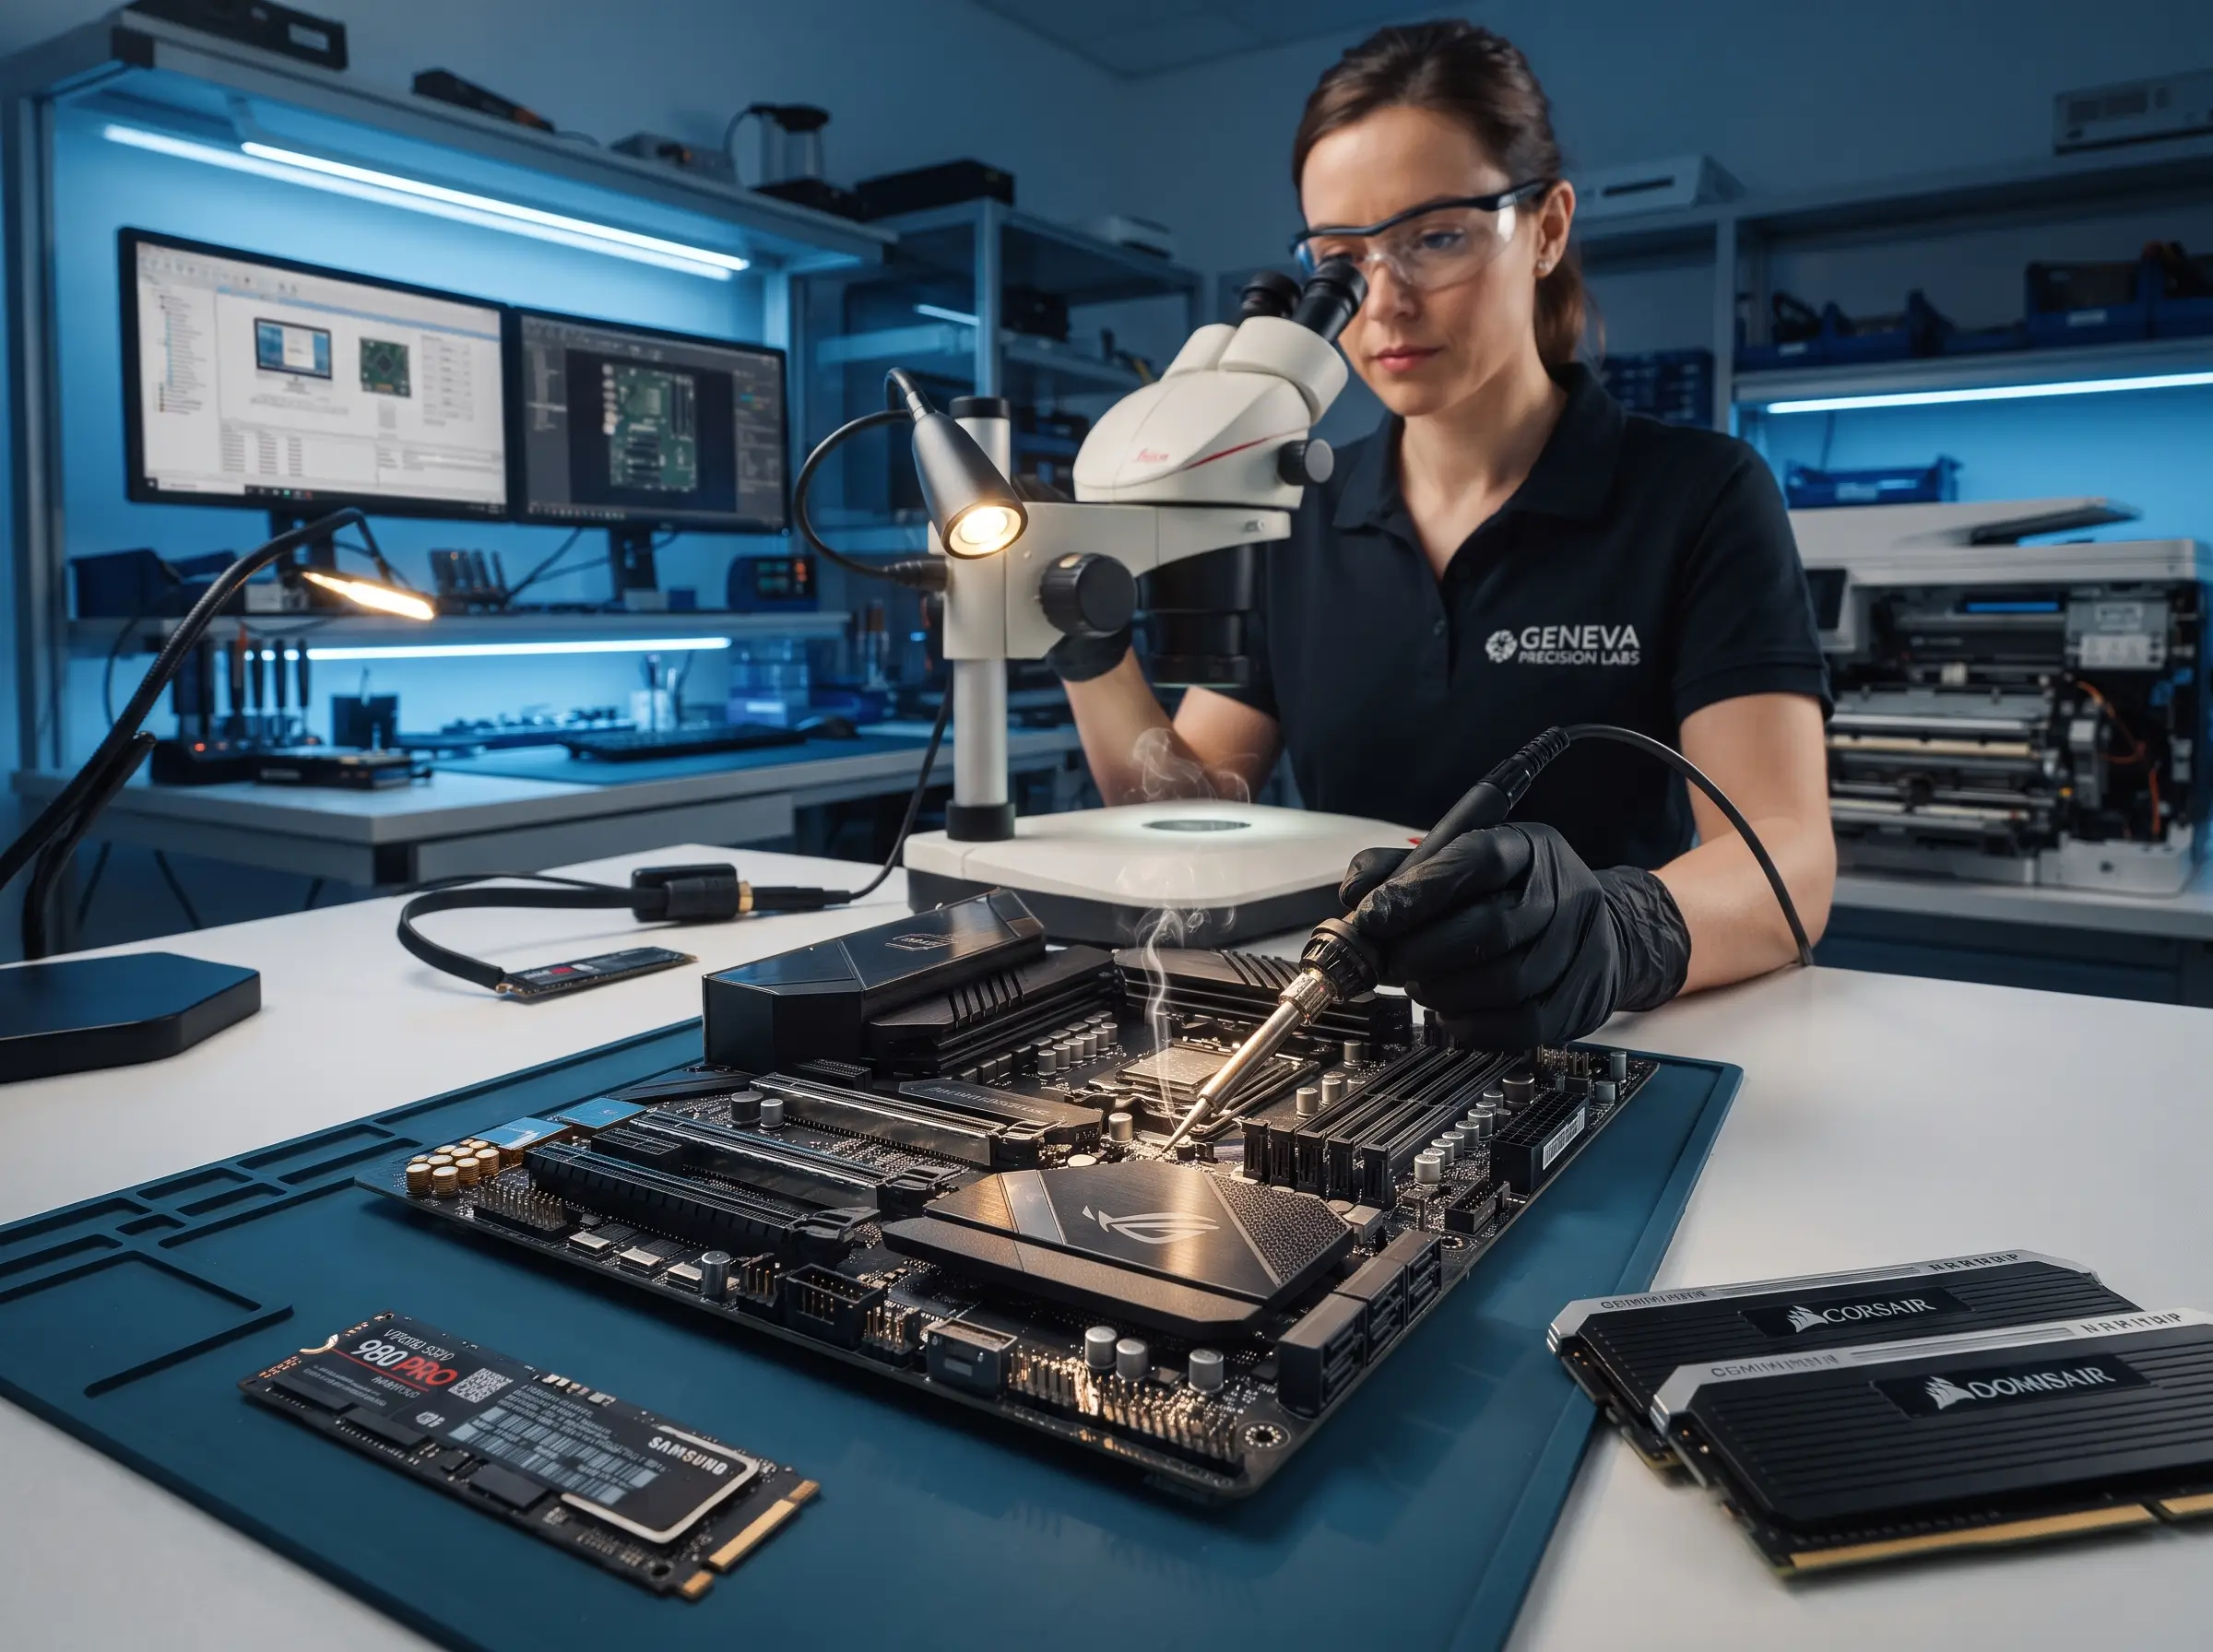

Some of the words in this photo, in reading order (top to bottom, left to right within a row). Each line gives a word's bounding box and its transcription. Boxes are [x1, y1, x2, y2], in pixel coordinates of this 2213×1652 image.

[1521, 624, 1640, 650] GENEVA
[1518, 650, 1597, 666] PRECISION
[1601, 650, 1640, 667] LABS
[1822, 1298, 1937, 1323] CORSAIR
[350, 1339, 408, 1367] 980
[391, 1356, 458, 1386] PRO
